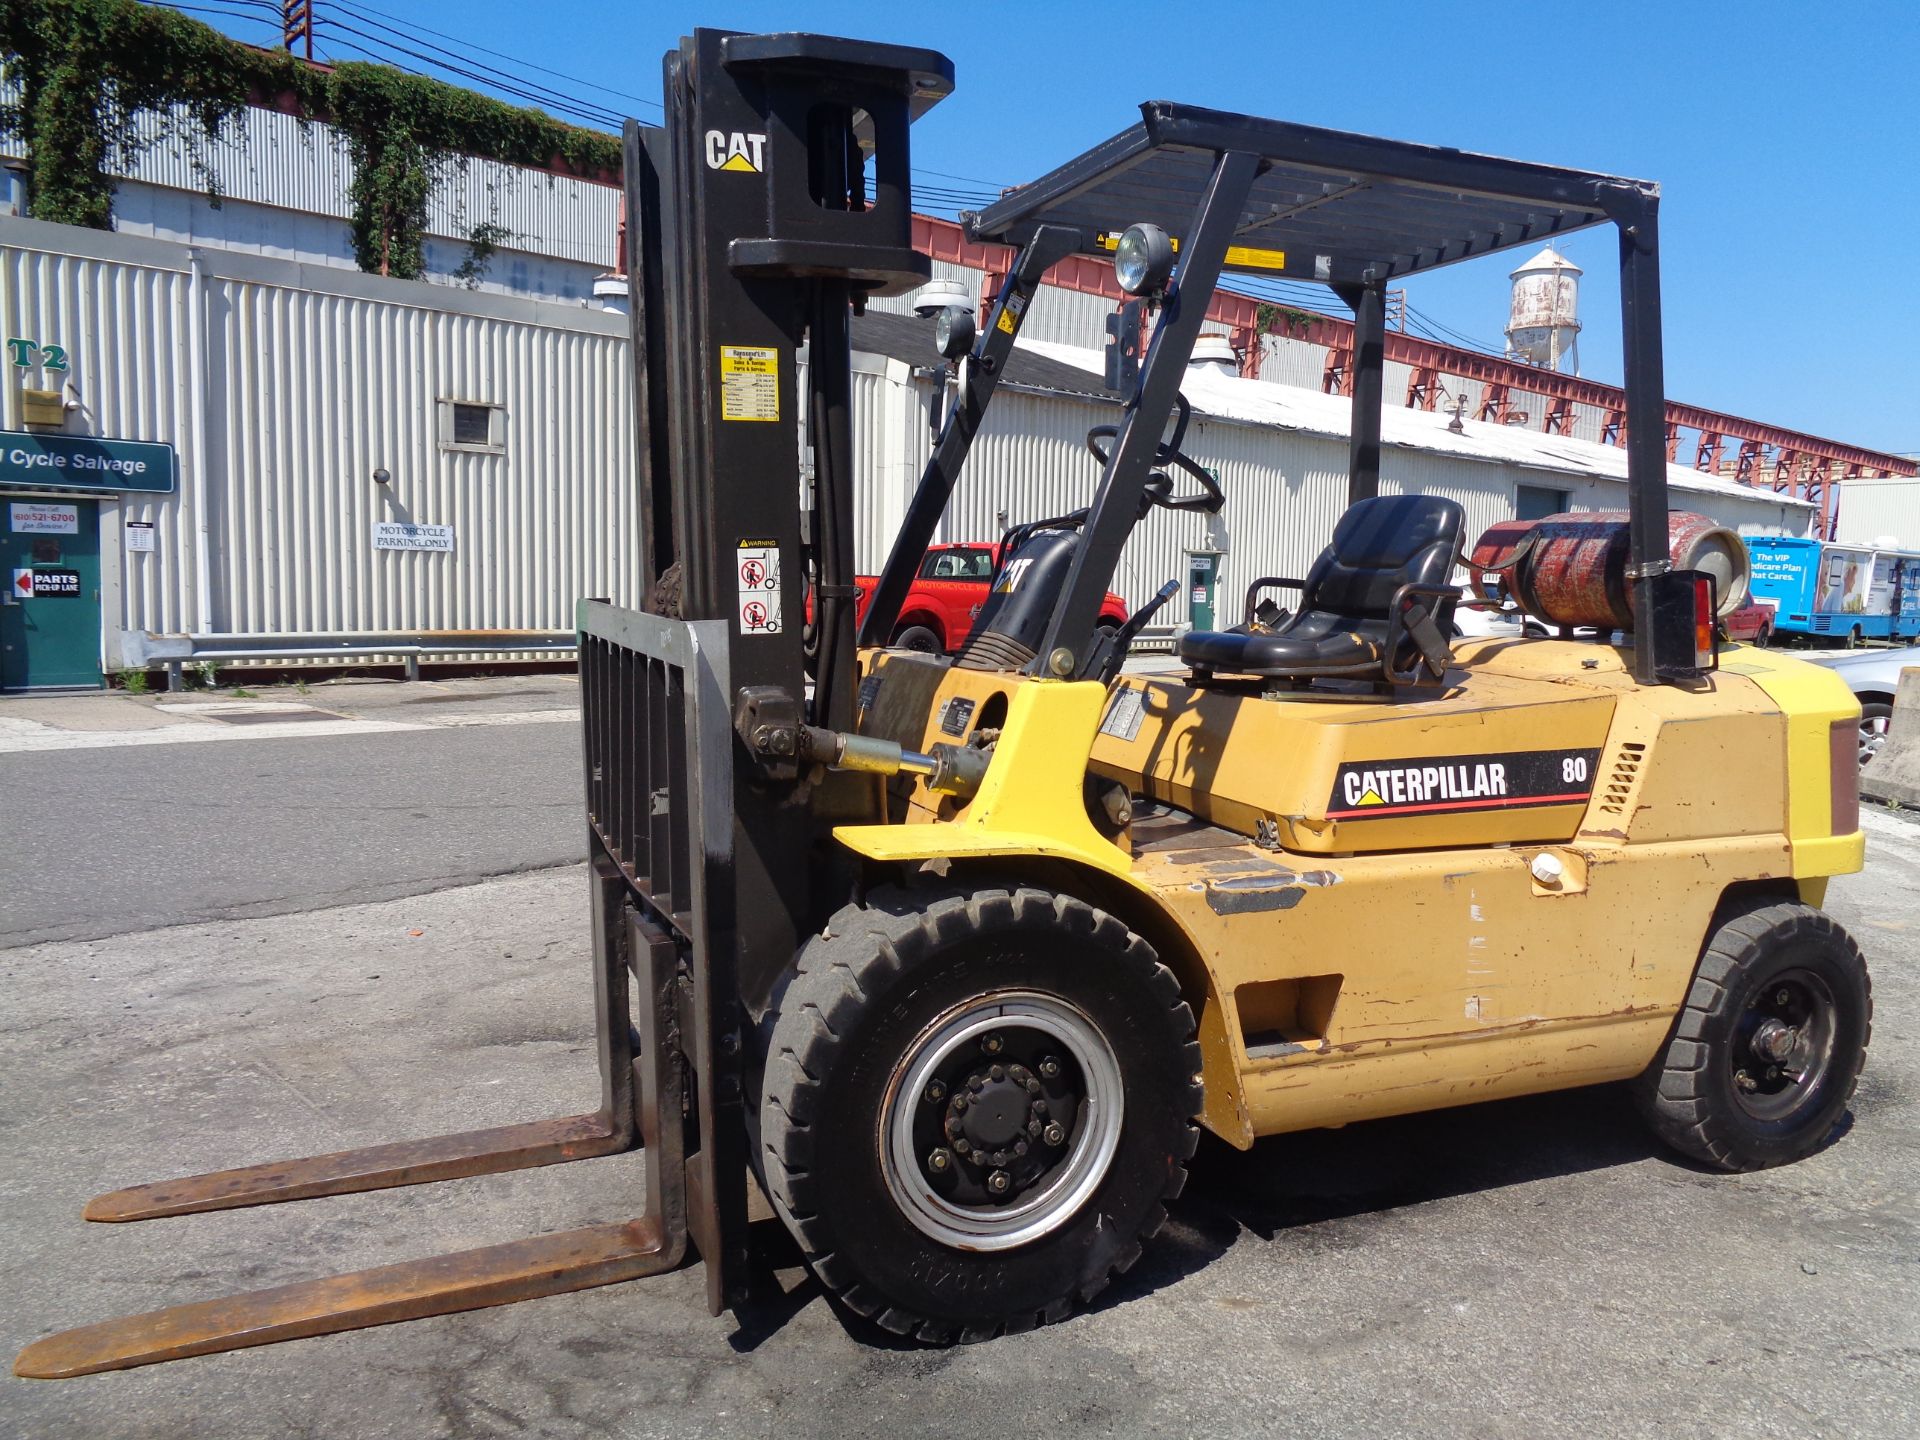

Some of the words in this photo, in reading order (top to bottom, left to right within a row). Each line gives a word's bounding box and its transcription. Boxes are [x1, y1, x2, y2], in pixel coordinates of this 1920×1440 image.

[705, 130, 766, 172] CAT
[10, 449, 66, 468] Cycle
[72, 453, 146, 475] Salvage
[380, 526, 445, 537] MOTORCYCLE
[377, 538, 420, 547] PARKING
[424, 539, 449, 548] ONLY
[1756, 553, 1773, 561] The
[1783, 563, 1801, 572] Plan
[34, 575, 79, 584] PARTS
[1768, 572, 1795, 581] Cares.
[1562, 757, 1587, 783] 80
[1343, 763, 1507, 806] CATERPILLAR
